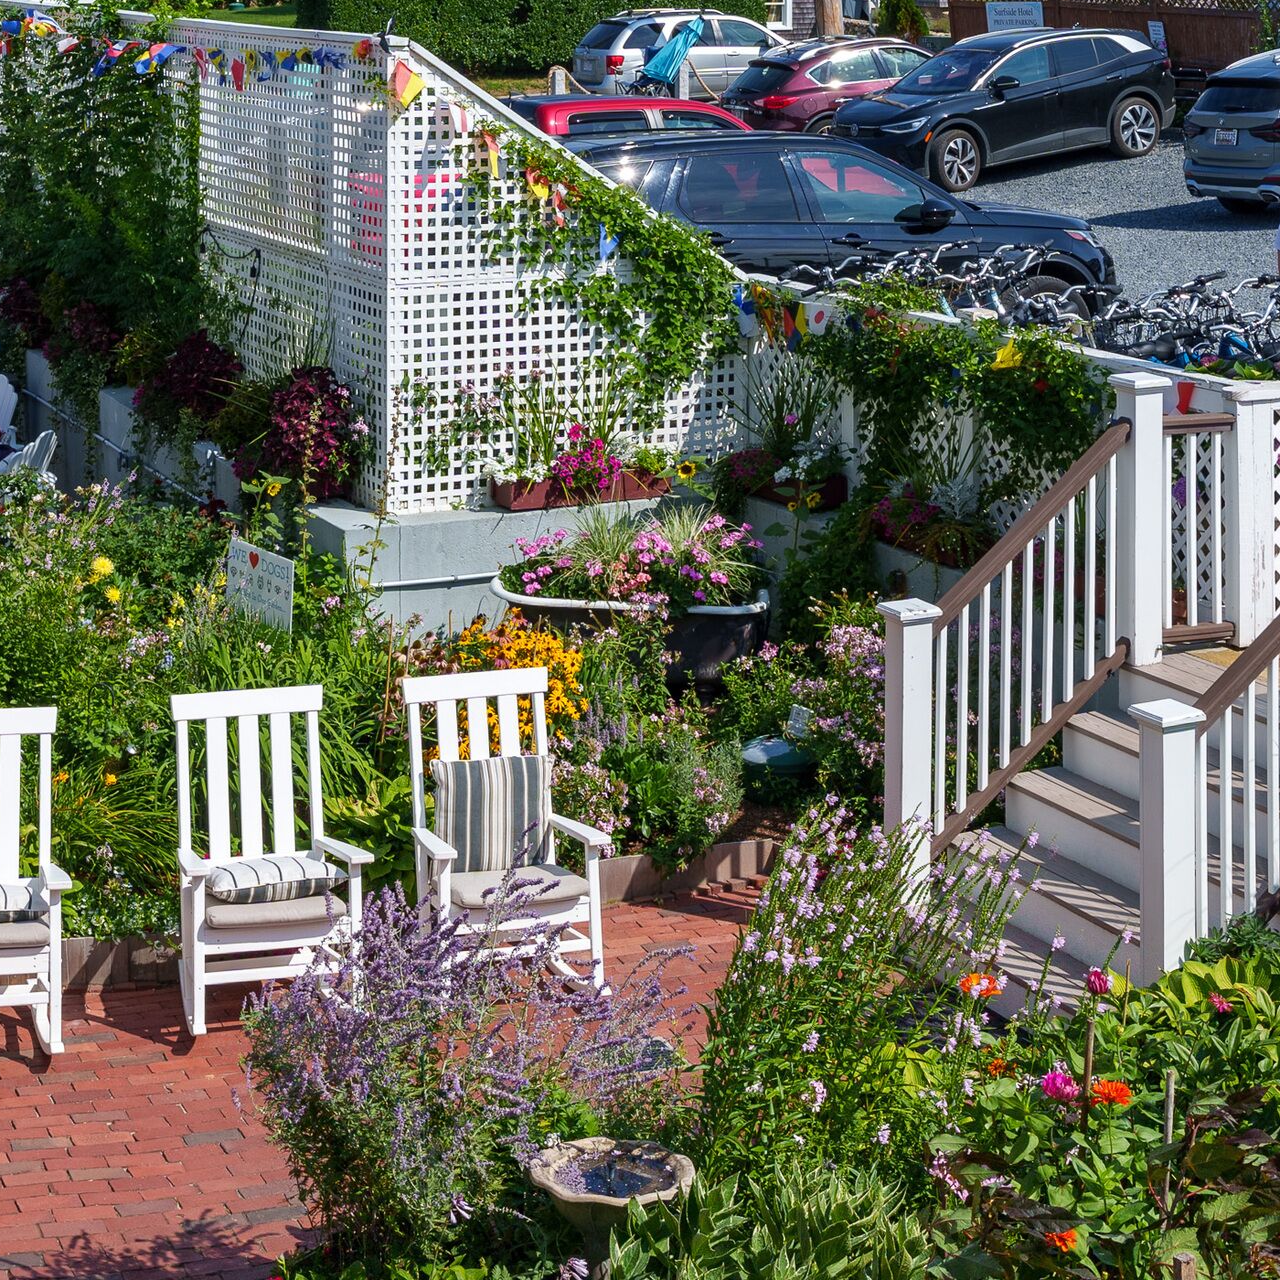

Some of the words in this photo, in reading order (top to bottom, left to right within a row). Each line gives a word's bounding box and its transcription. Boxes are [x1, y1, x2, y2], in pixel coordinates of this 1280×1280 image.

[993, 8, 1017, 16] Surfside
[1017, 8, 1034, 16] Hotel
[231, 546, 247, 564] WE
[261, 558, 289, 583] DOGS!
